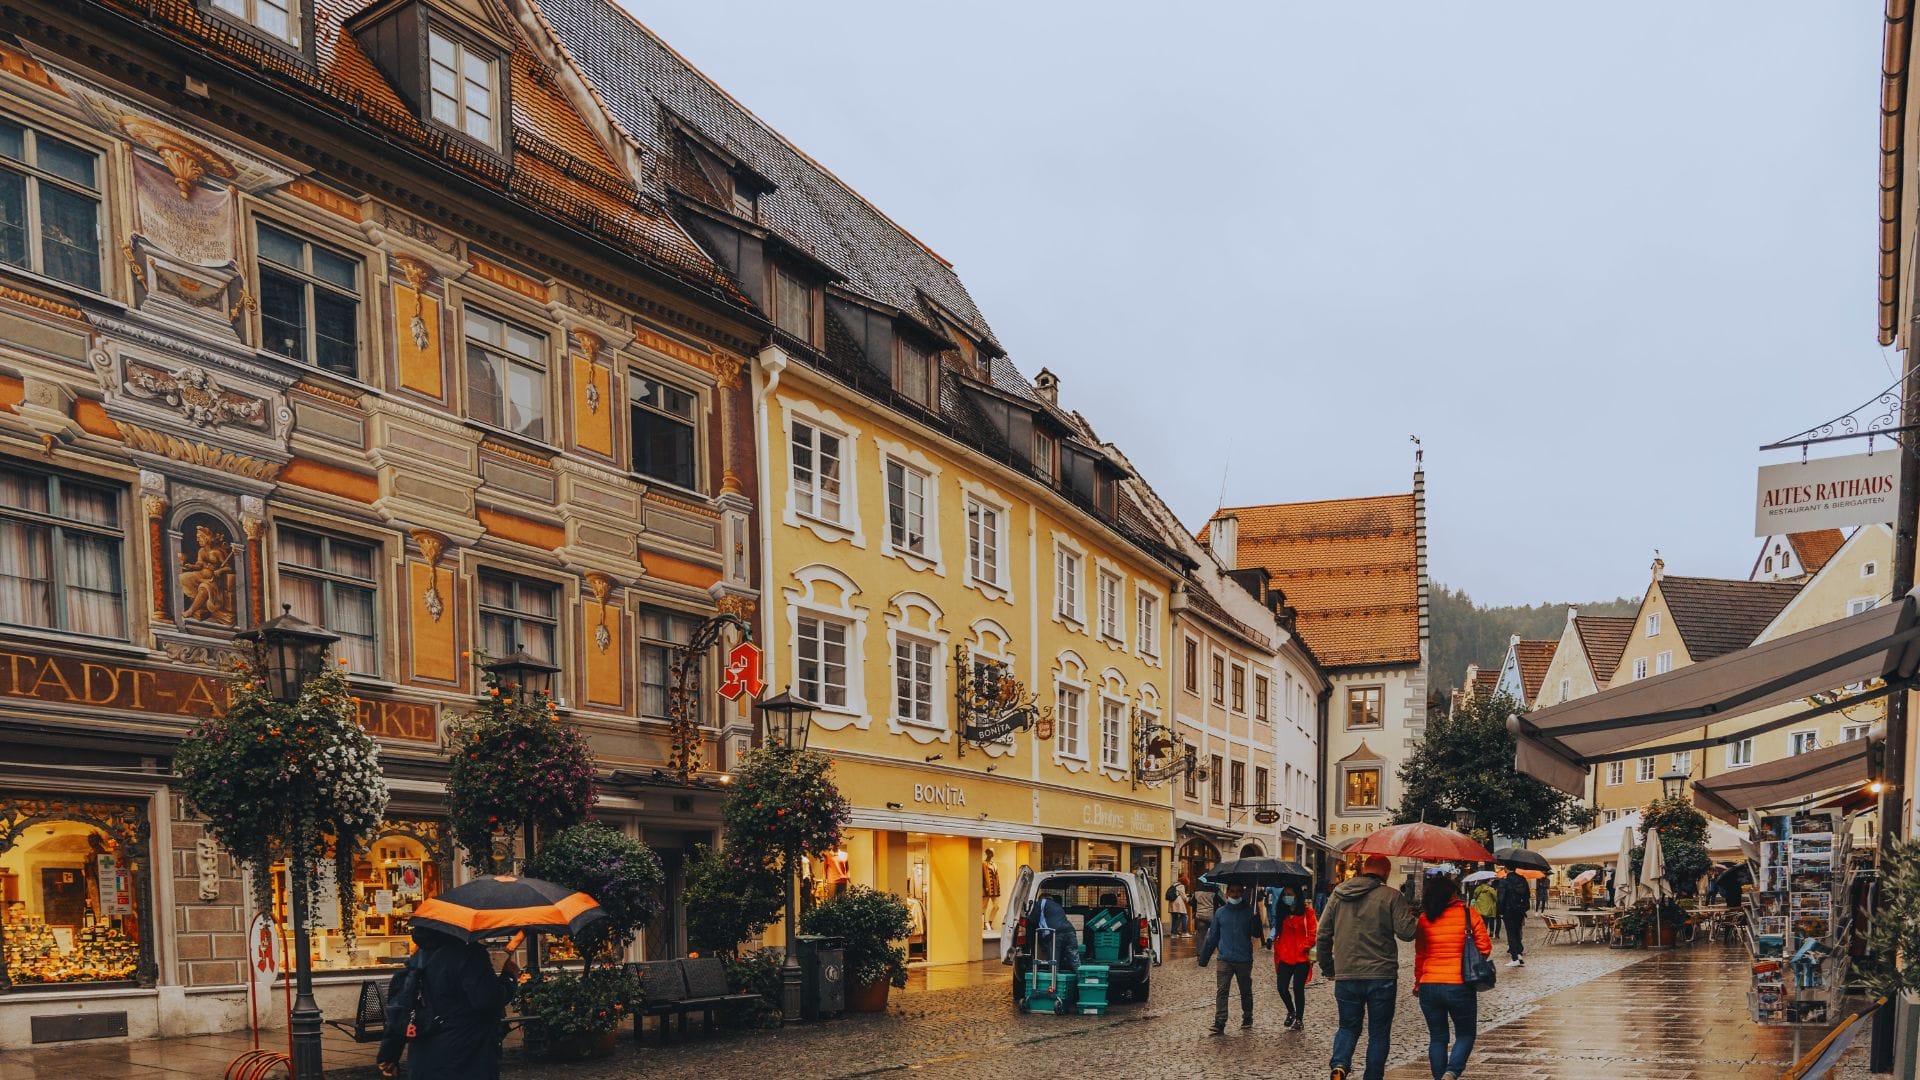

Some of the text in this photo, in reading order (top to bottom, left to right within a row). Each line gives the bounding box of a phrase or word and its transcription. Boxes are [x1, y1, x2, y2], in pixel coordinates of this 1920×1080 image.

[1763, 475, 1893, 508] ALTES RATHAUS
[1769, 504, 1821, 516] RESTAURANT
[1832, 497, 1885, 509] BIERGARTEN
[979, 723, 1011, 739] BONITA
[915, 782, 966, 810] BONITA
